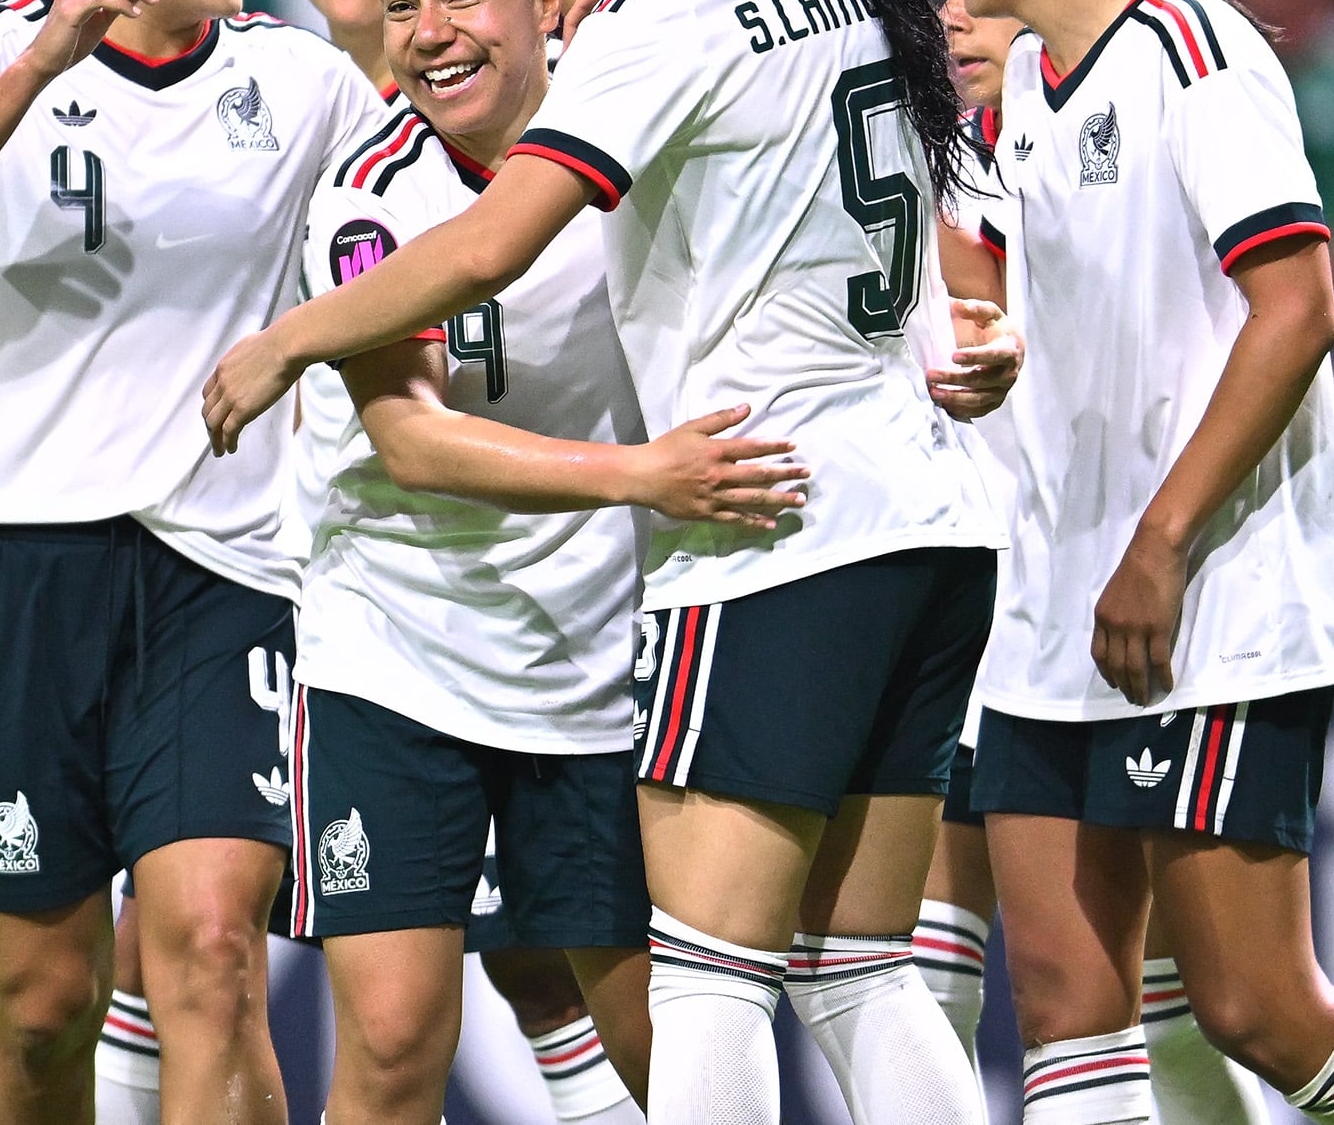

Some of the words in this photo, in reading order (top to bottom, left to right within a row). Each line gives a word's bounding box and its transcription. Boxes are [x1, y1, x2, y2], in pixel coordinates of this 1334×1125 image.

[50, 145, 107, 255] 4
[336, 230, 377, 245] Concacaf
[831, 58, 923, 341] 5
[447, 298, 508, 404] 9
[248, 646, 291, 757] 4
[322, 876, 367, 892] MÉXICO
